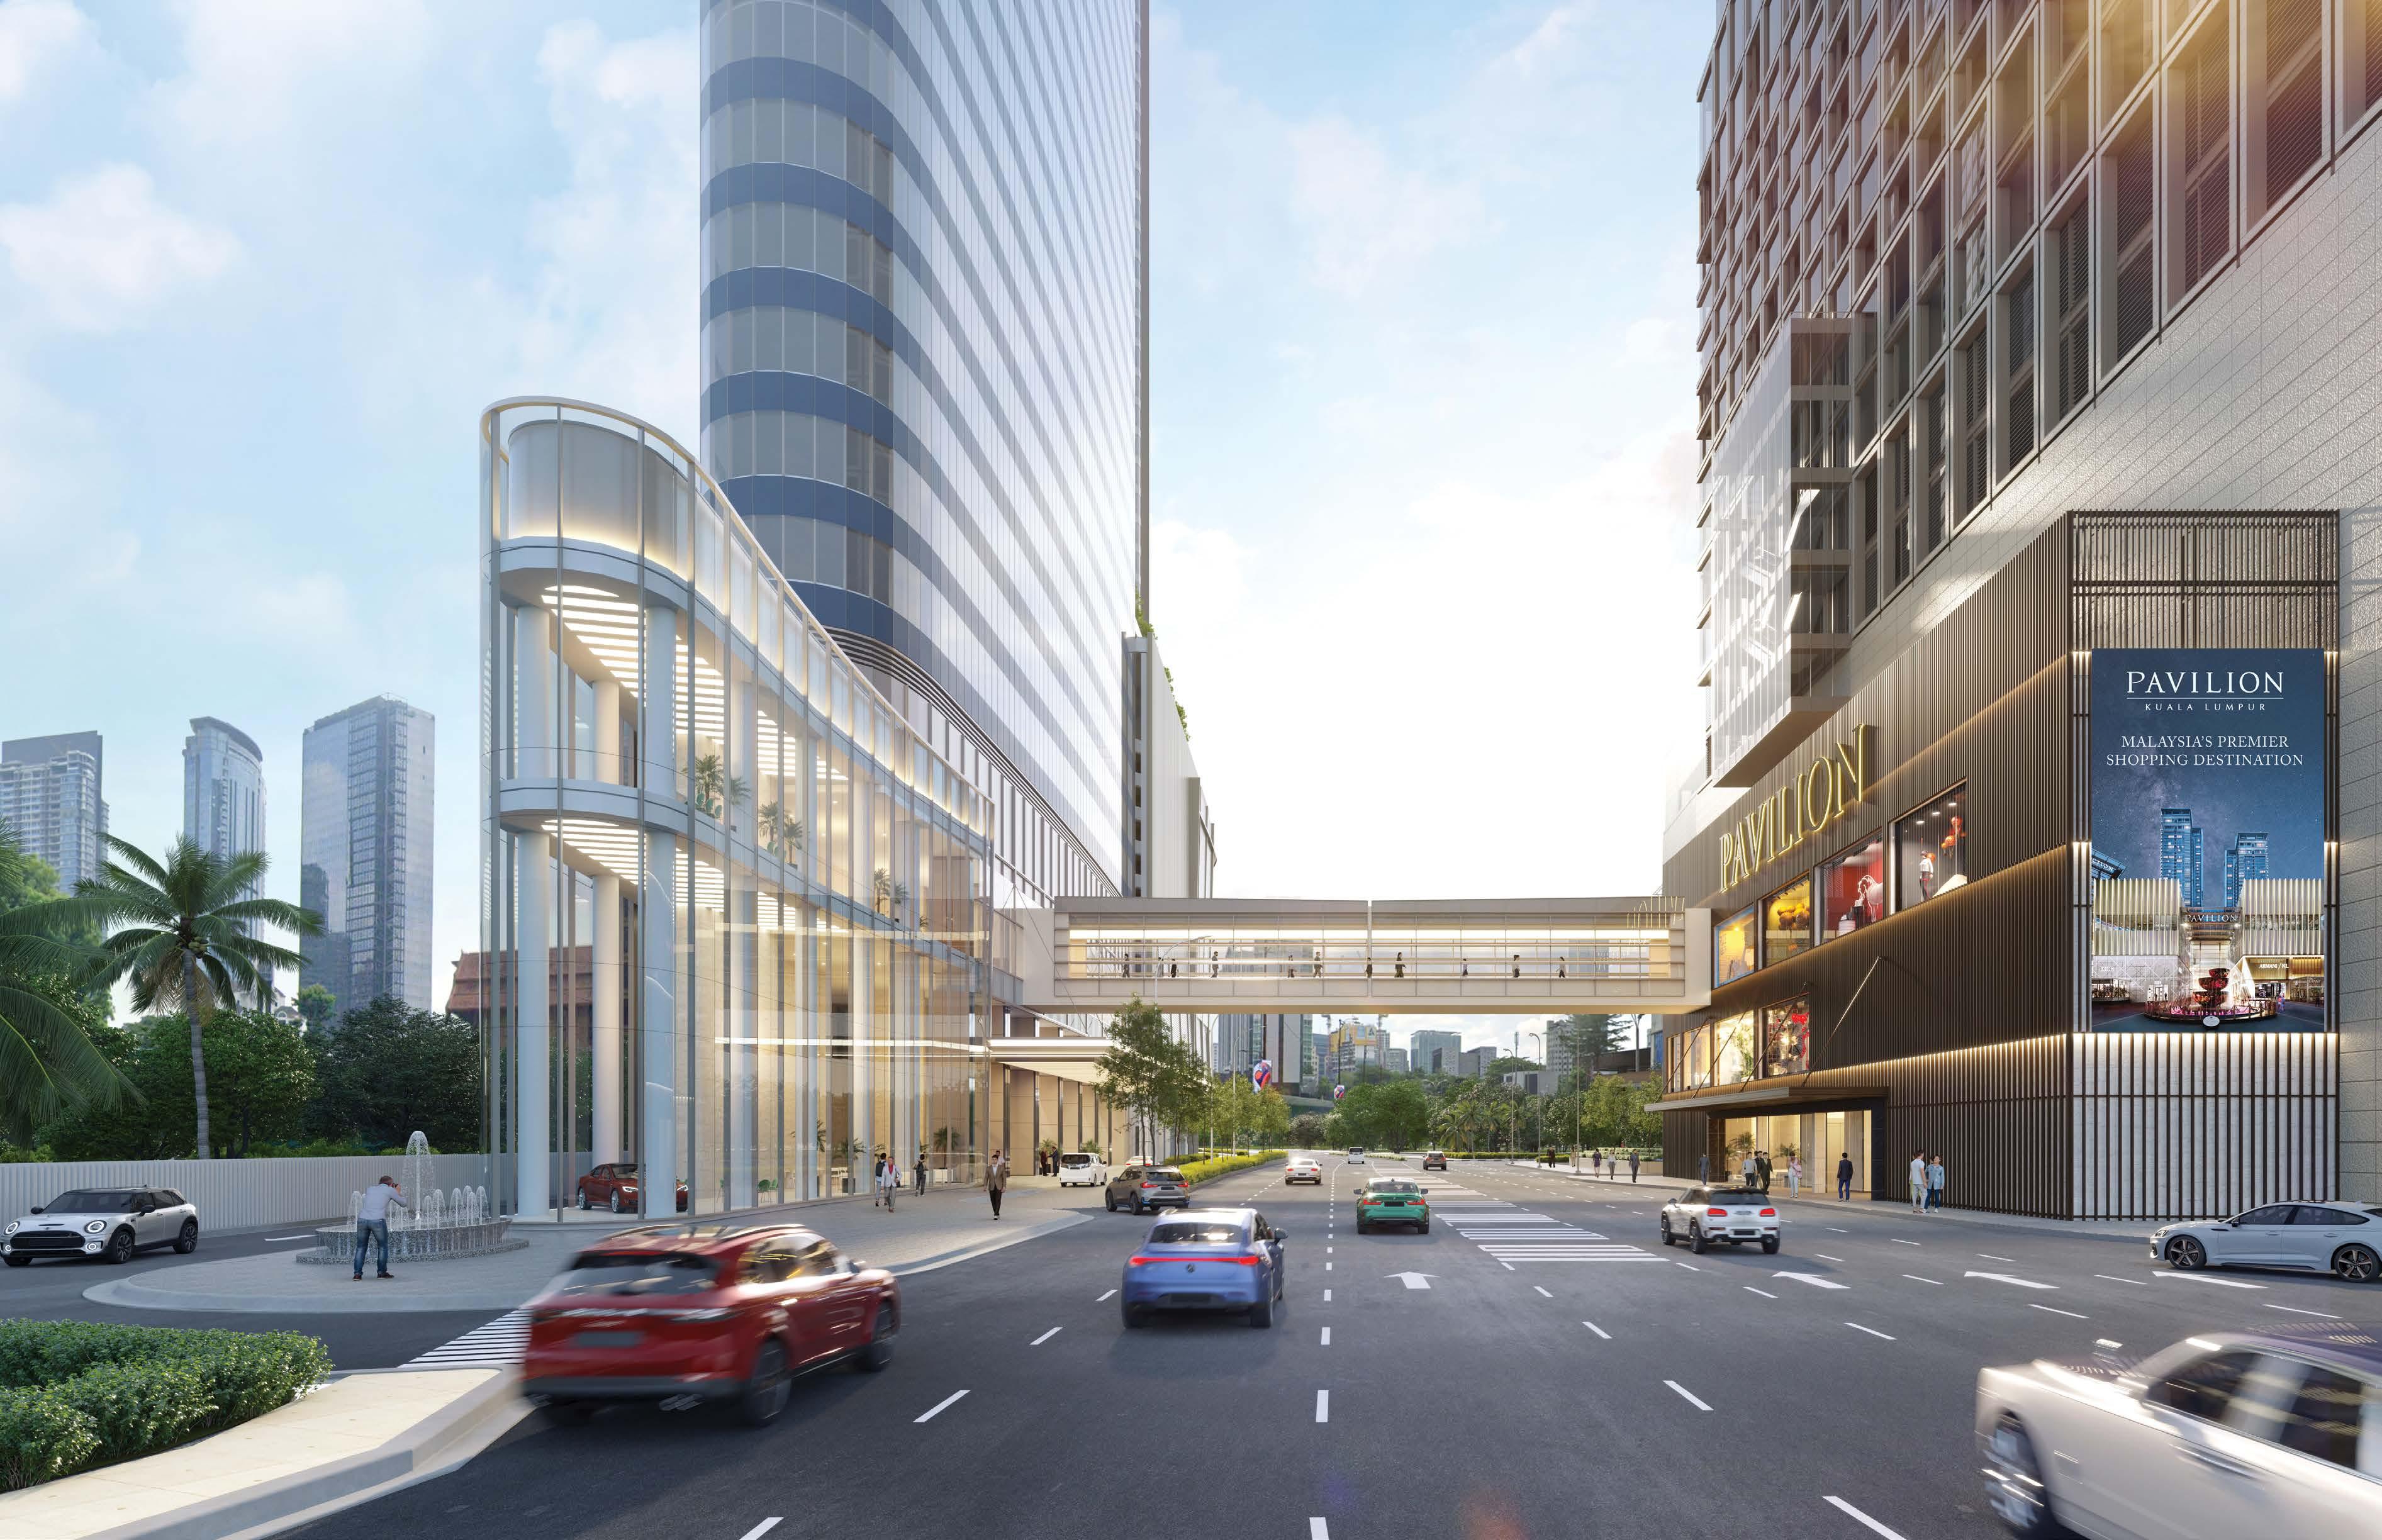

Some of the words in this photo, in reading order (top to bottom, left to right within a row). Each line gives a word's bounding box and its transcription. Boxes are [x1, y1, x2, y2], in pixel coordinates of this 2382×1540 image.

[2127, 671, 2284, 693] PAVILION
[2121, 735, 2213, 747] MALAYSIA'S
[2217, 736, 2289, 747] PREMIER
[2106, 754, 2189, 766] SHOPPING
[2193, 754, 2303, 766] DESTINATION
[1719, 723, 1869, 893] PAVILION
[2185, 914, 2237, 922] PAVILION
